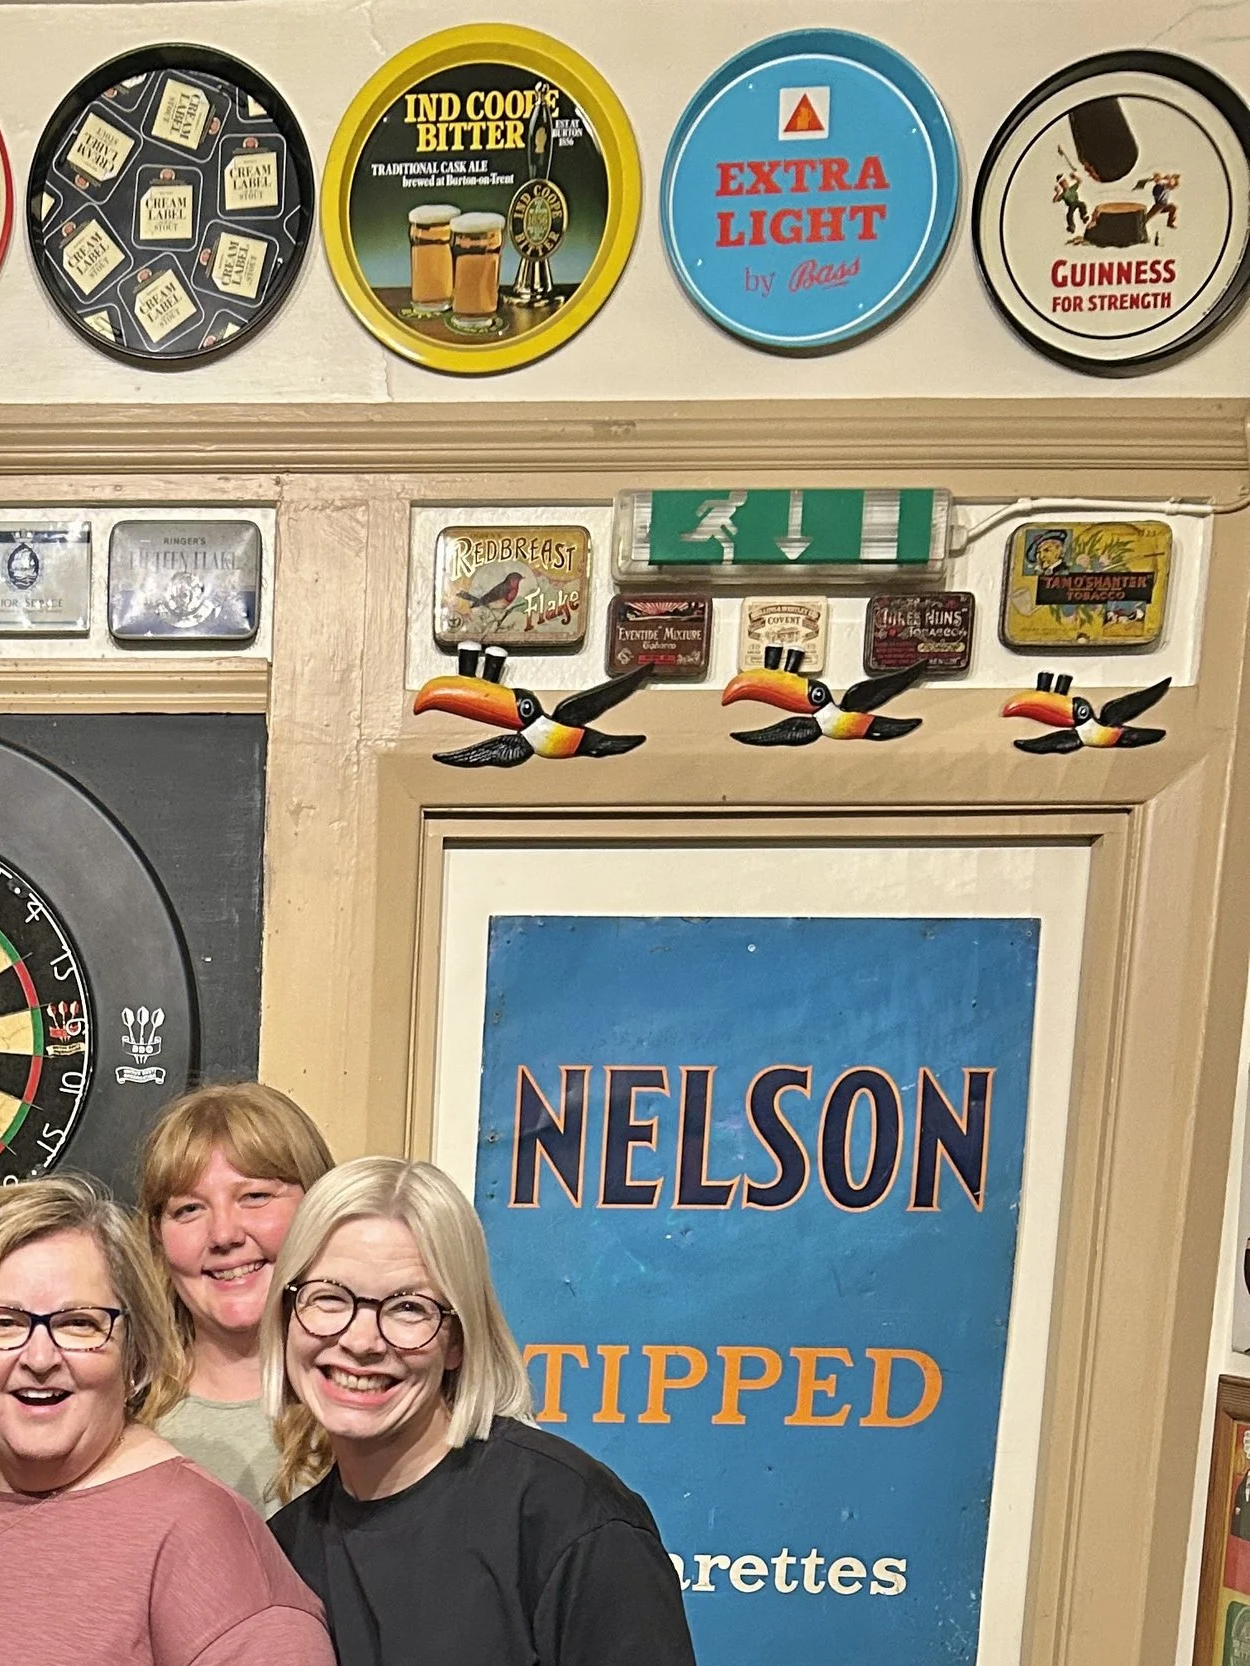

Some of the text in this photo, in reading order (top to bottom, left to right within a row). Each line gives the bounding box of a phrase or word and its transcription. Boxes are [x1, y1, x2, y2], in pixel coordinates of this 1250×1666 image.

[403, 92, 460, 123] IND
[416, 120, 526, 152] BITTER
[229, 165, 272, 180] CREAM
[371, 159, 488, 177] TRADITIONAL CASK ALE
[715, 155, 890, 197] EXTRA
[233, 176, 272, 190] LABEL
[402, 175, 435, 188] brewed
[436, 175, 445, 187] at
[145, 196, 188, 210] CREAM
[513, 184, 563, 219] IND COOPE
[148, 208, 187, 221] LABEL
[715, 203, 887, 248] LIGHT
[515, 231, 560, 257] BITTER
[743, 256, 861, 298] by Bass
[1051, 259, 1176, 288] GUINNESS
[1052, 292, 1172, 313] FOR STRENGTH
[163, 537, 206, 545] RINGER'S
[1067, 591, 1125, 600] TOBACCO
[524, 587, 580, 632] Flake
[767, 616, 801, 626] COVENT
[663, 627, 702, 641] MIXTURE
[23, 897, 44, 924] 4
[132, 1045, 153, 1053] BDO
[507, 1065, 996, 1213] NELSON
[522, 1344, 943, 1428] TIPPED
